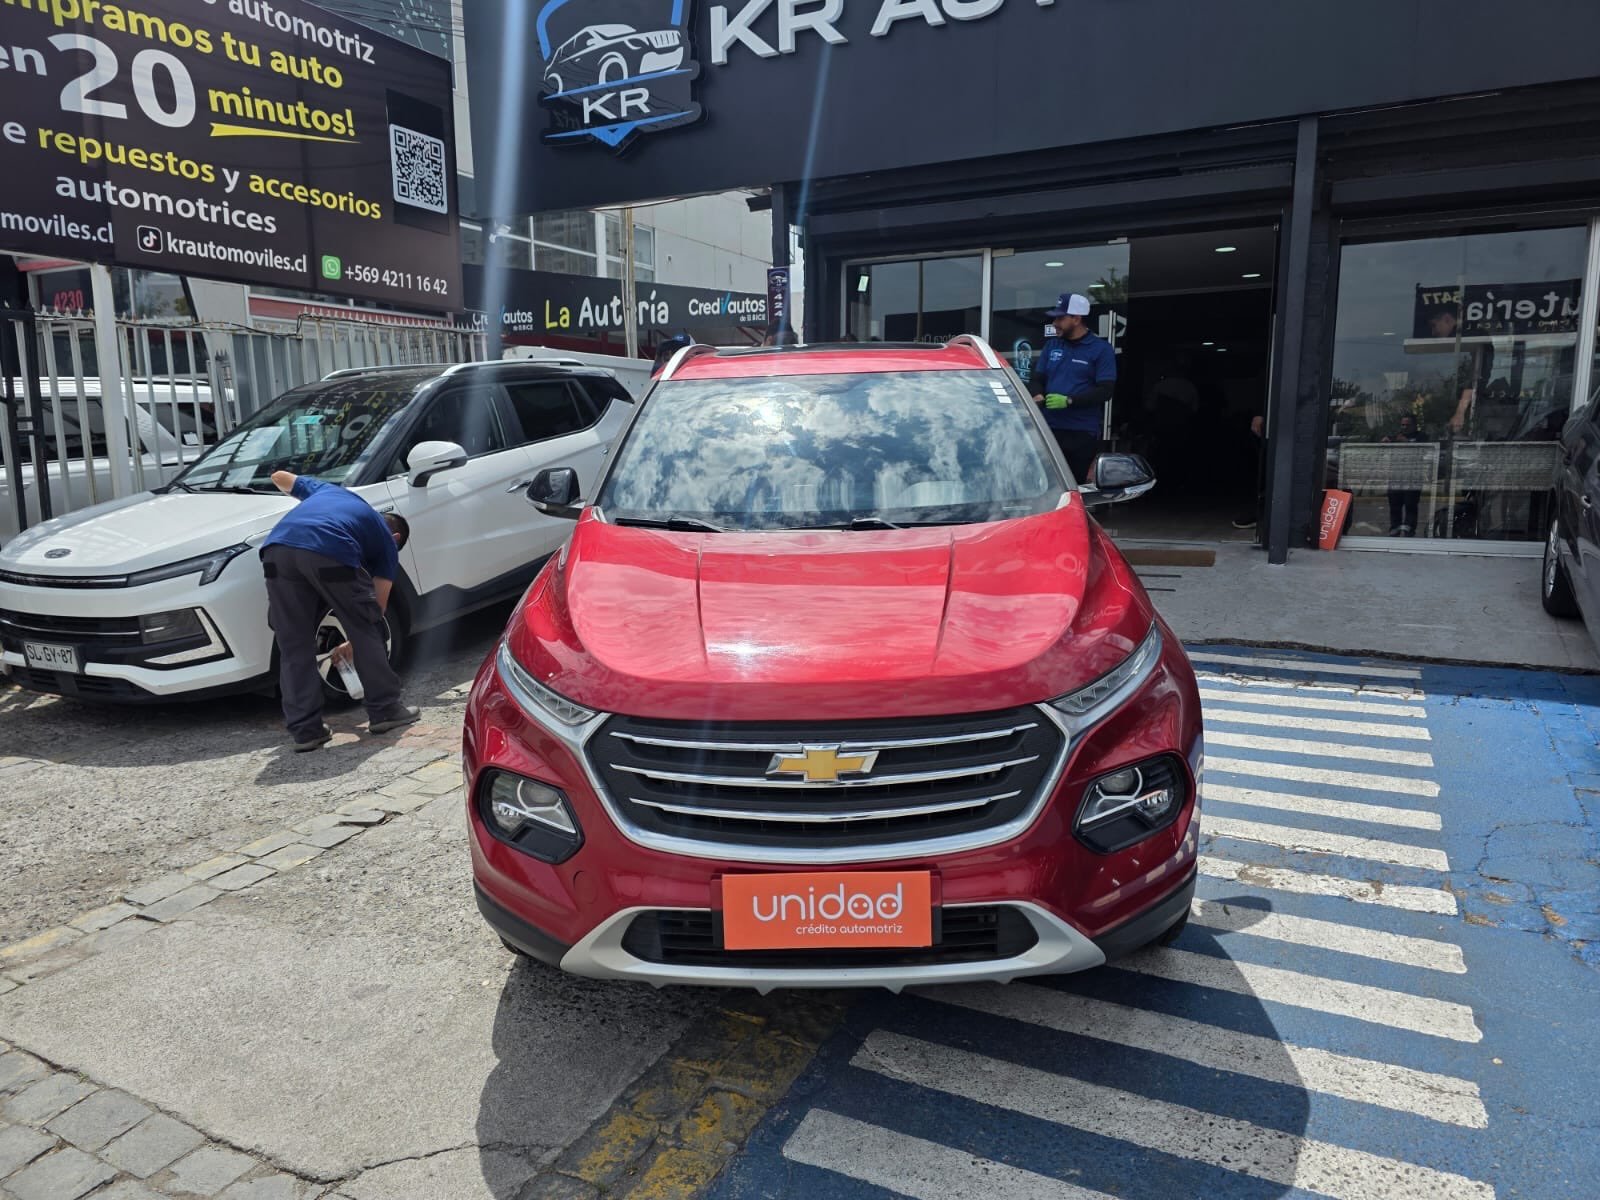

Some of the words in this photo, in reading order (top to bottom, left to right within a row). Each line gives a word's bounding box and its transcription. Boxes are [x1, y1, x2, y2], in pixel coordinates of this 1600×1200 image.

[229, 0, 375, 64] automotriz
[710, 0, 848, 65] KR
[222, 32, 261, 67] tu
[270, 51, 343, 88] auto
[48, 33, 196, 128] 20
[208, 87, 355, 136] minutos!
[583, 88, 650, 123] KR
[38, 128, 215, 183] repuestos
[222, 168, 240, 193] y
[250, 174, 381, 219] accesorios
[56, 176, 277, 233] automotrices
[167, 232, 307, 273] krautomoviles.cl
[345, 265, 379, 284] +569
[382, 270, 412, 288] 4211
[417, 275, 431, 292] 16
[433, 279, 448, 295] 42
[546, 299, 570, 329] La
[578, 289, 669, 328] Autría
[1319, 498, 1339, 540] unidad
[753, 882, 903, 921] unidad
[796, 923, 836, 934] crédito
[840, 923, 903, 934] automotriz
